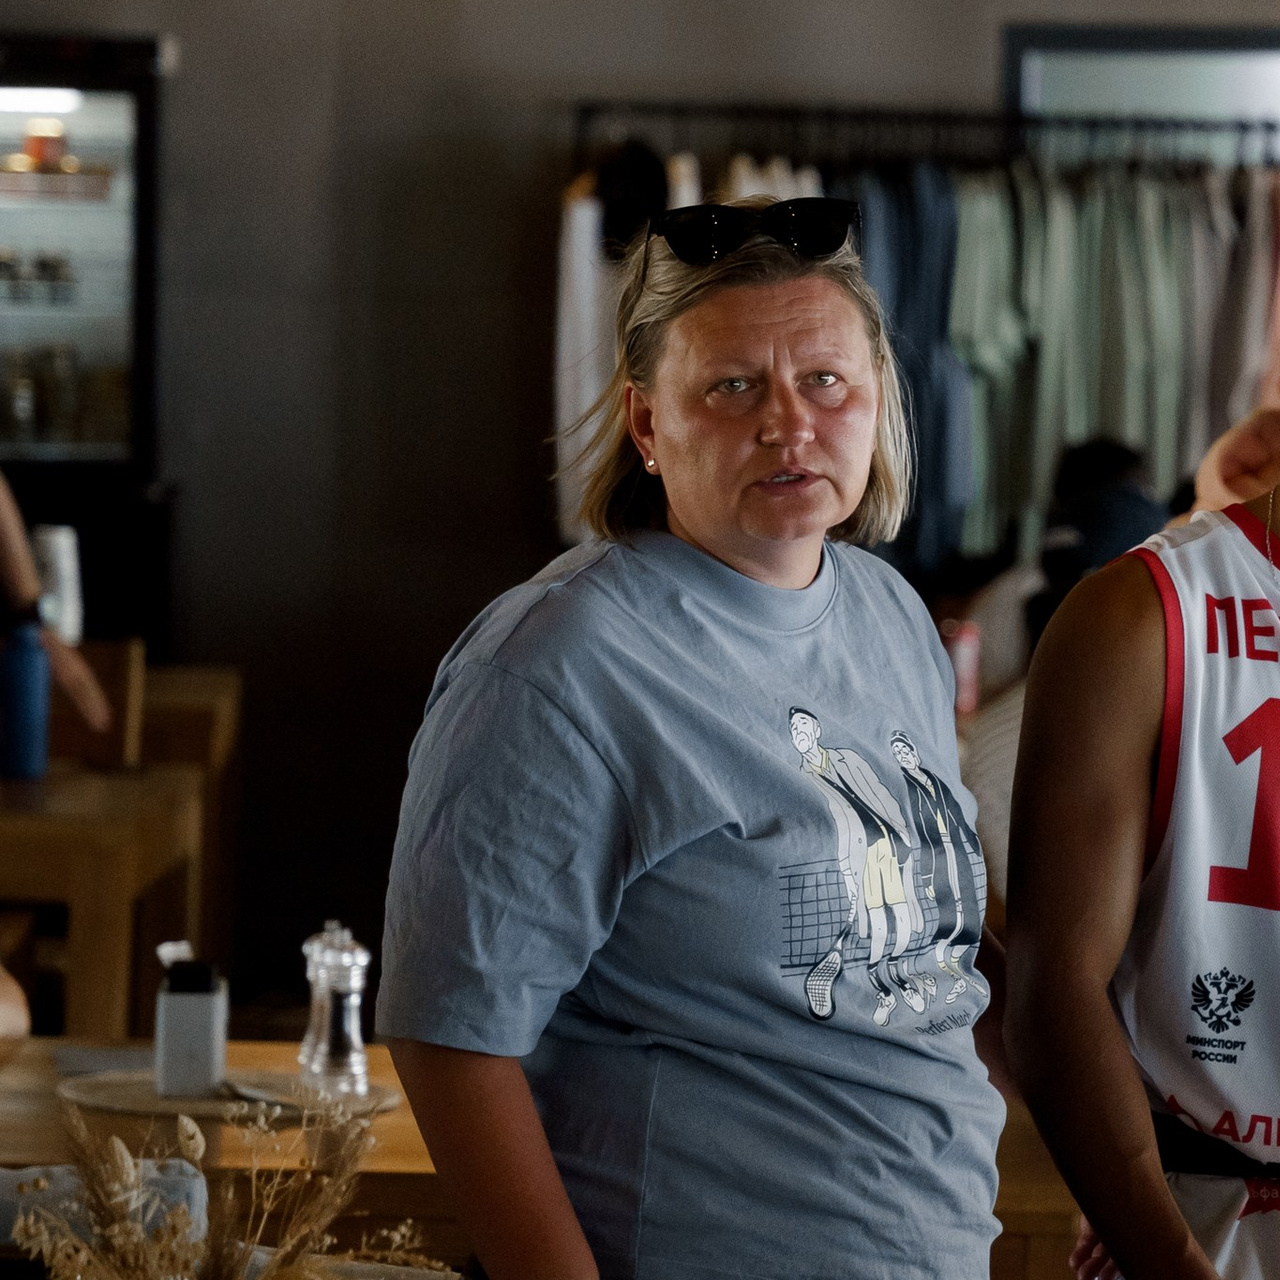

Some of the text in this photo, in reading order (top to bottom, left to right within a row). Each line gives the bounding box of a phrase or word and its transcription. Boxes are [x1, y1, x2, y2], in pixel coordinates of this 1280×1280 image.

[1186, 1034, 1246, 1051] МИНСПОРТ
[1191, 1050, 1238, 1064] РОССИИ
[1251, 1185, 1280, 1201] ьфа
